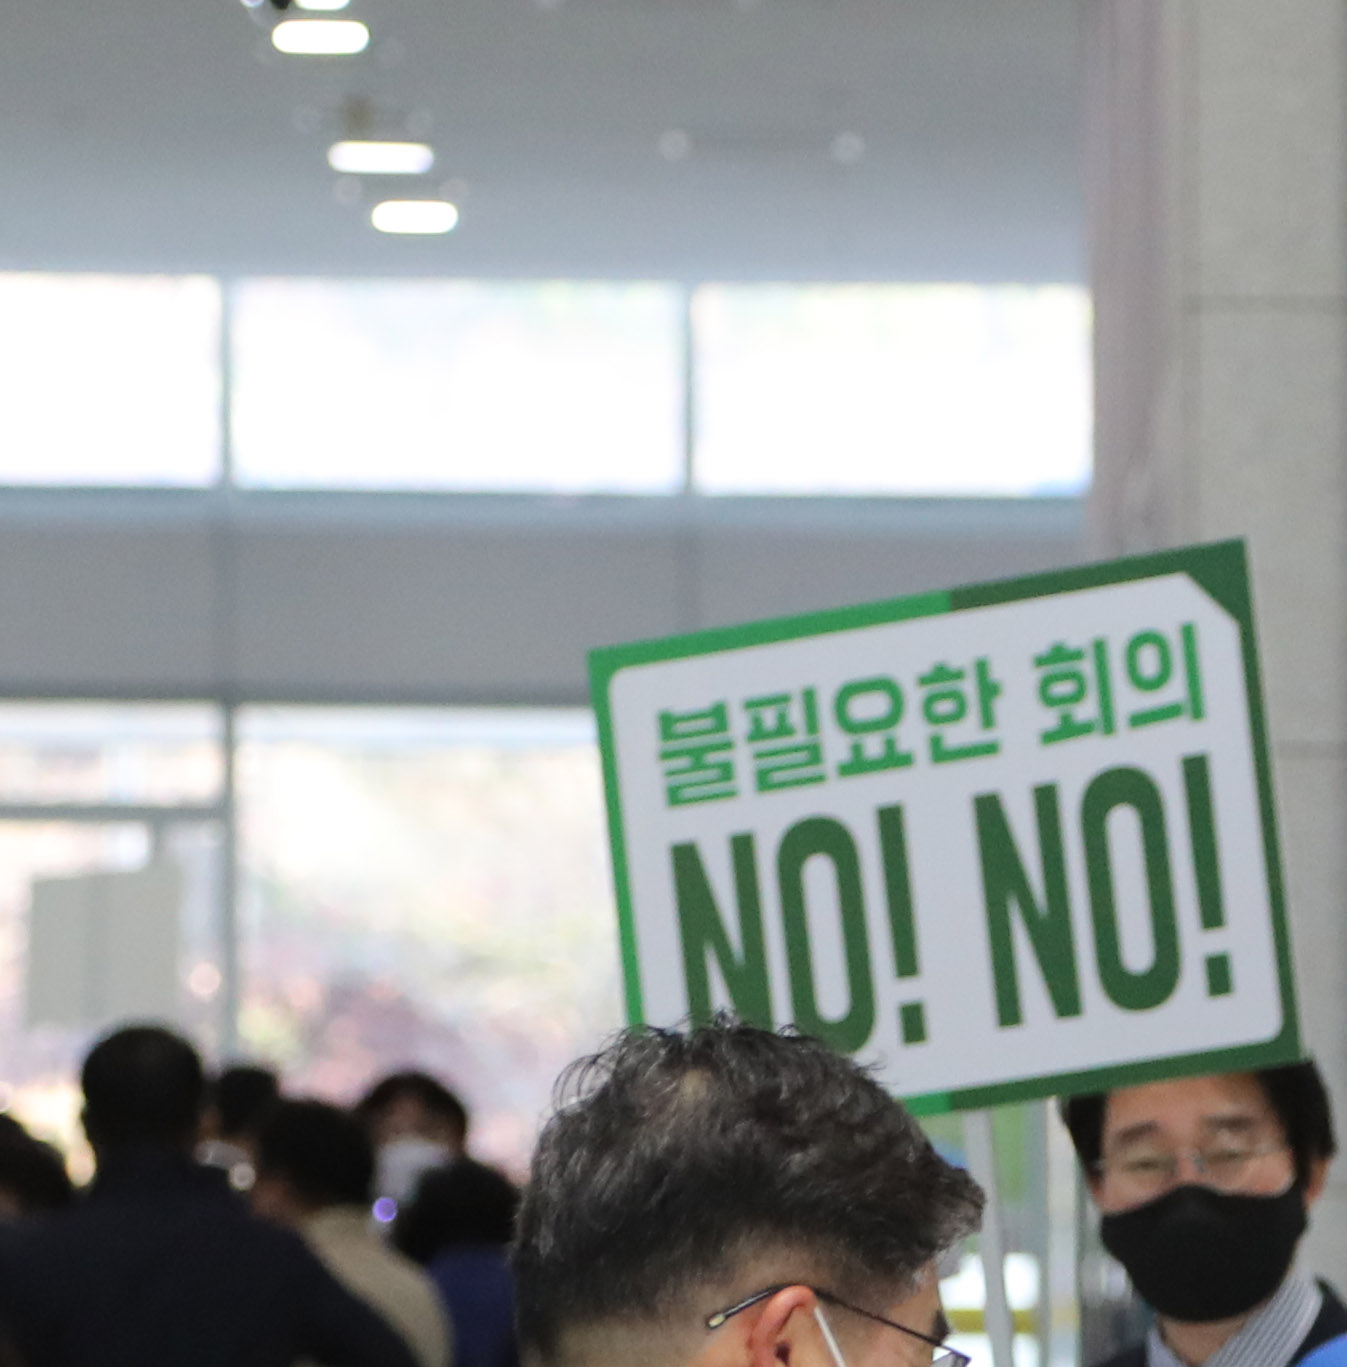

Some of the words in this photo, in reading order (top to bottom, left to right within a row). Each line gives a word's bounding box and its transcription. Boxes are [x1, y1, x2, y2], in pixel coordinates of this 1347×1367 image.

[656, 656, 1002, 809] 불필요한
[1032, 622, 1205, 747] 회의
[669, 802, 927, 1056] NO!
[972, 750, 1235, 1030] NO!
